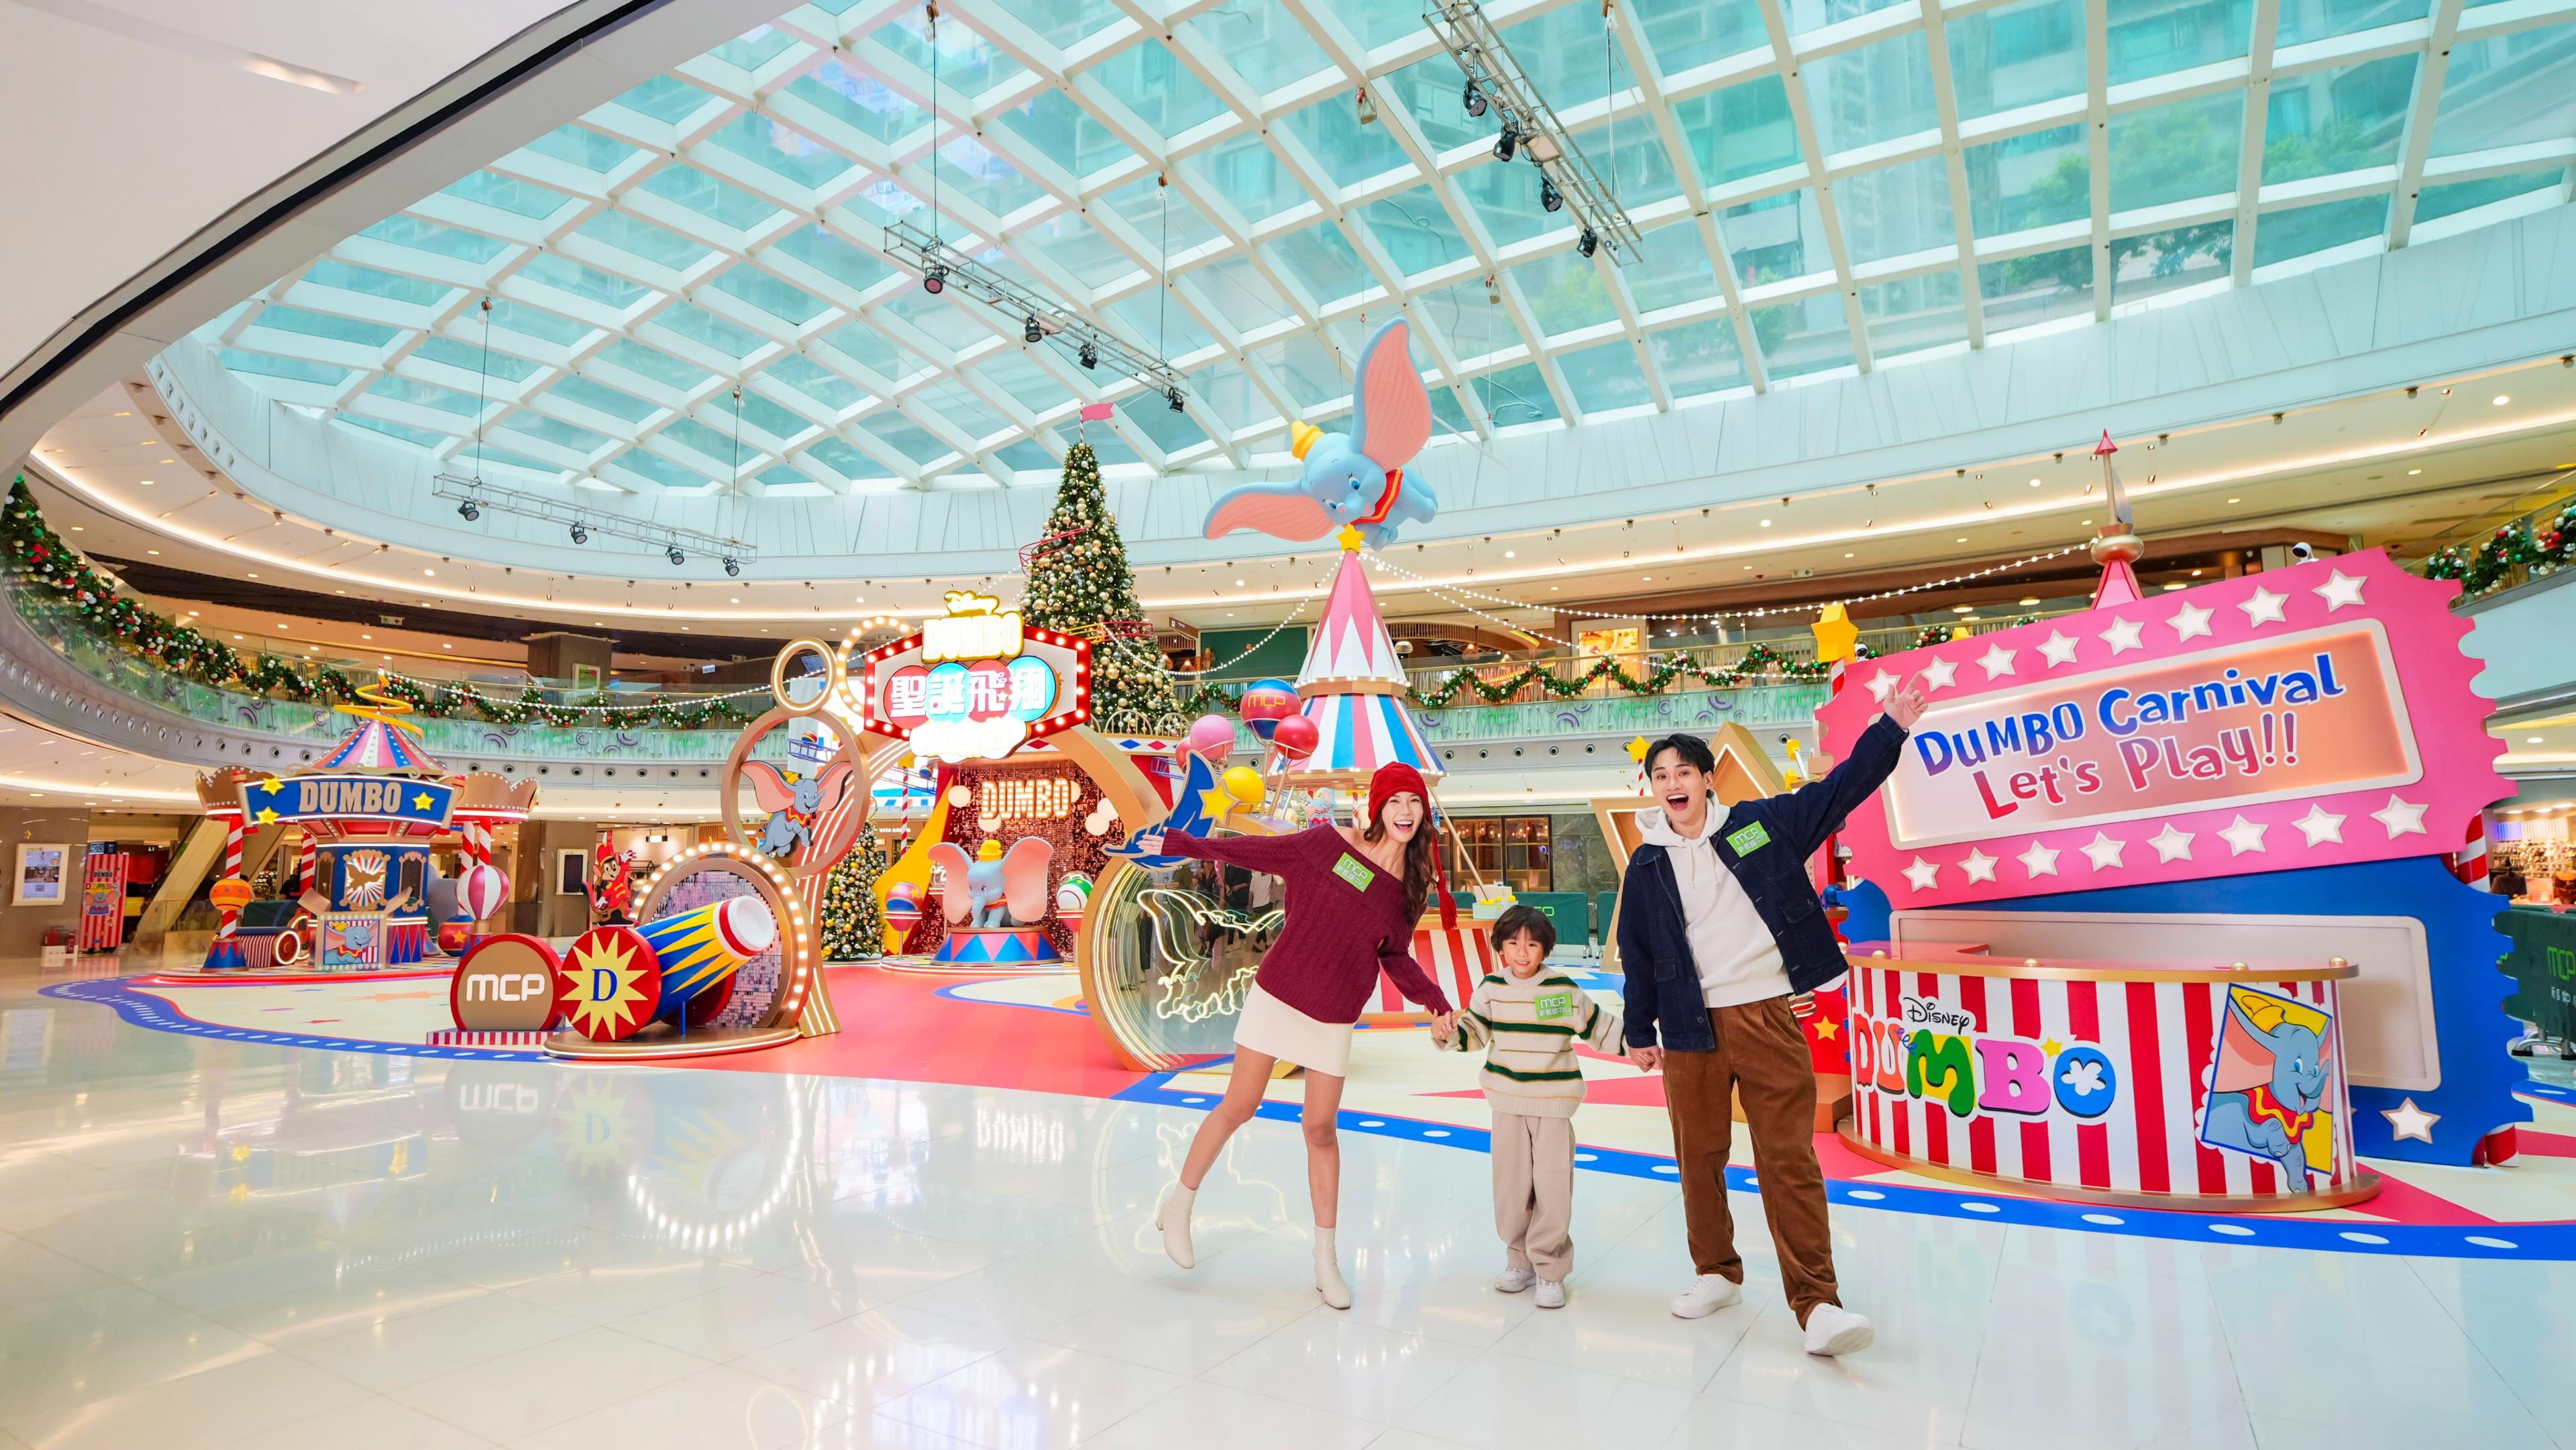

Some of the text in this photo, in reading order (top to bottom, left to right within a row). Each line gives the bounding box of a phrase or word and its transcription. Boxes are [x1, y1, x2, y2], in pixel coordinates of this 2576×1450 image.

[890, 667, 1046, 717] 聖誕飛翔
[1248, 693, 1286, 709] MCP
[1778, 690, 1825, 709] MCP
[2098, 654, 2345, 737] Carnival
[1972, 713, 2298, 819] Let's Play!!
[299, 781, 402, 813] DUMBO
[981, 778, 1069, 820] DUMBO
[1734, 827, 1758, 845] MCP
[1343, 859, 1368, 879] MCP
[2547, 946, 2576, 981] MCP
[466, 974, 545, 1001] MCP
[590, 968, 618, 1001] D
[1540, 996, 1566, 1008] MCP
[1854, 1012, 2116, 1118] DUMBO
